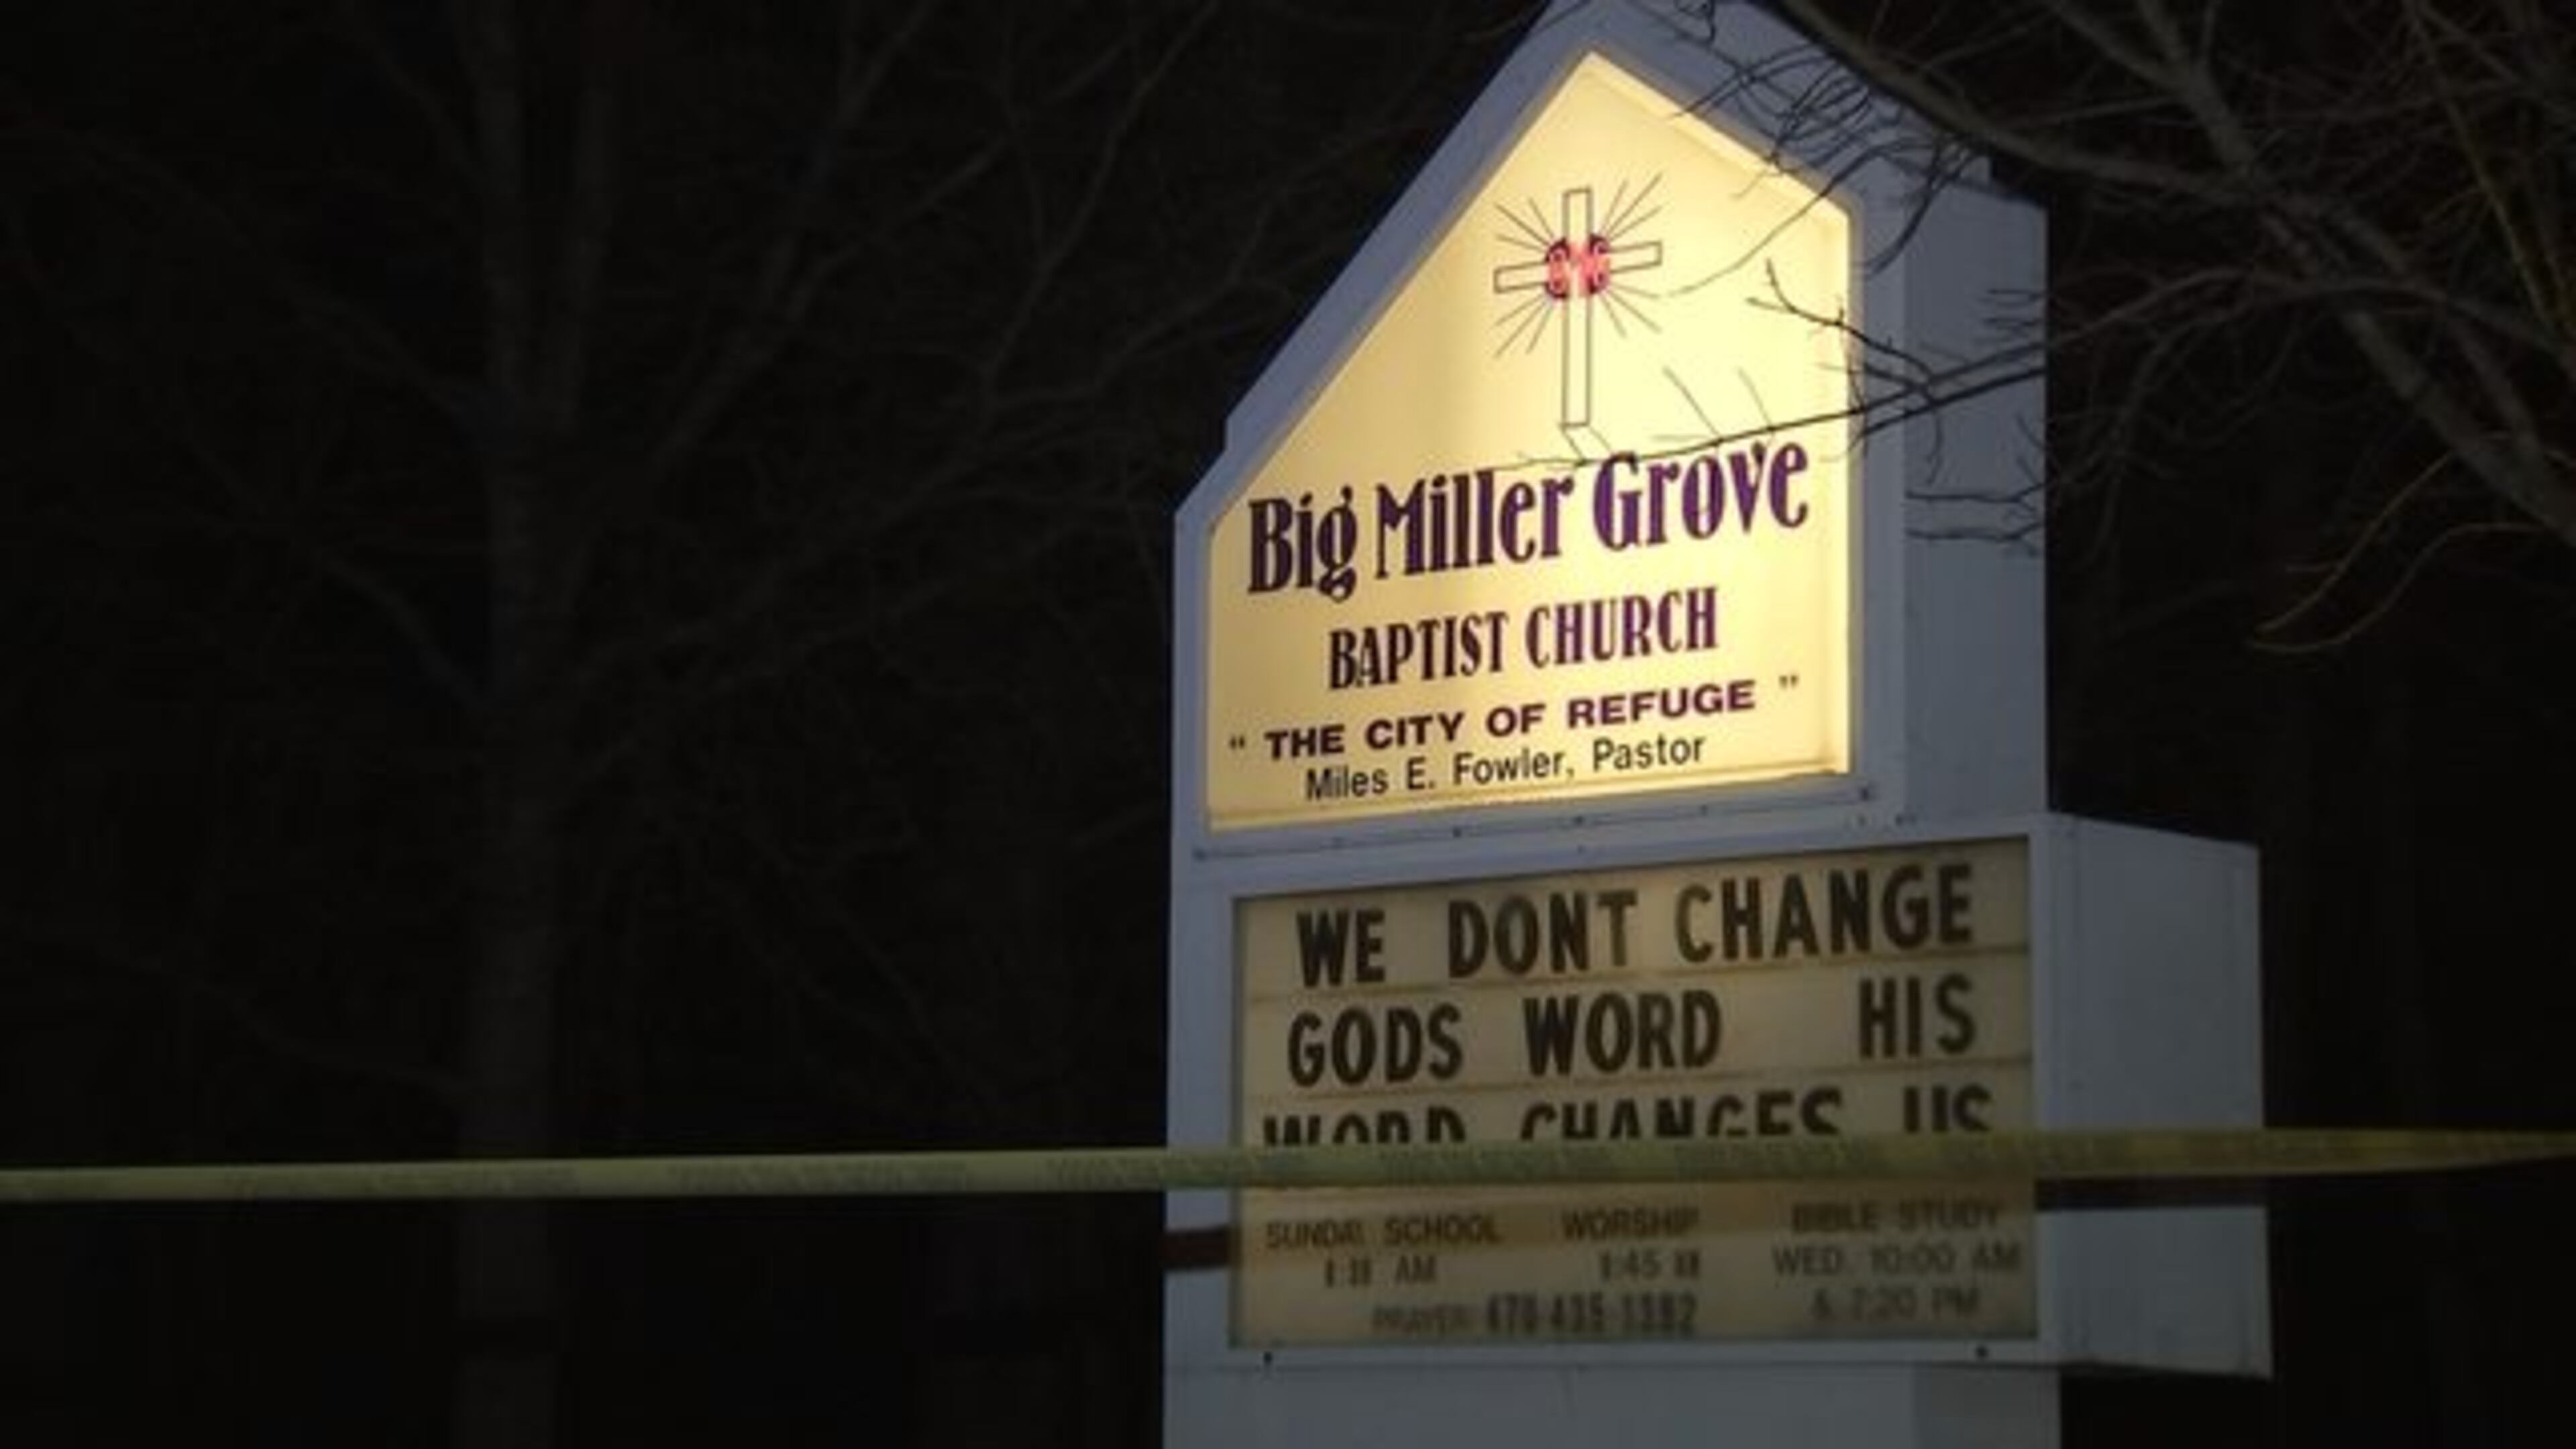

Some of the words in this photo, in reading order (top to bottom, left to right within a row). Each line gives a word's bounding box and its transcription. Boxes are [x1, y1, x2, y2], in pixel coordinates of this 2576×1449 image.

[1248, 486, 1358, 602] Big
[1376, 467, 1574, 579] Miller
[1593, 441, 1809, 551] Grove
[1329, 610, 1510, 692] BAPTIST
[1524, 586, 1719, 669] CHURCH
[1265, 725, 1345, 761] THE
[1364, 711, 1464, 751] CITY
[1486, 702, 1546, 739] OF
[1567, 679, 1756, 729] REFUGE
[1305, 759, 1389, 802] Miles
[1406, 755, 1436, 790] E.
[1453, 745, 1575, 787] Fowler,
[1592, 734, 1705, 773] Pastor
[1297, 908, 1386, 988] WE
[1448, 889, 1638, 978] DONT
[1674, 863, 1974, 964] CHANGE
[1287, 1003, 1464, 1087] GODS
[1523, 989, 1723, 1076] WORD
[1856, 974, 1977, 1059] HIS
[1383, 1213, 1503, 1246] SCHOOL
[1562, 1208, 1701, 1241] WORSHIP
[1898, 1198, 2004, 1231] STUDY
[1395, 1254, 1437, 1285] AM
[1869, 1241, 1957, 1275] 10:00
[1972, 1241, 2022, 1270] AM
[1933, 1286, 1980, 1317] PM
